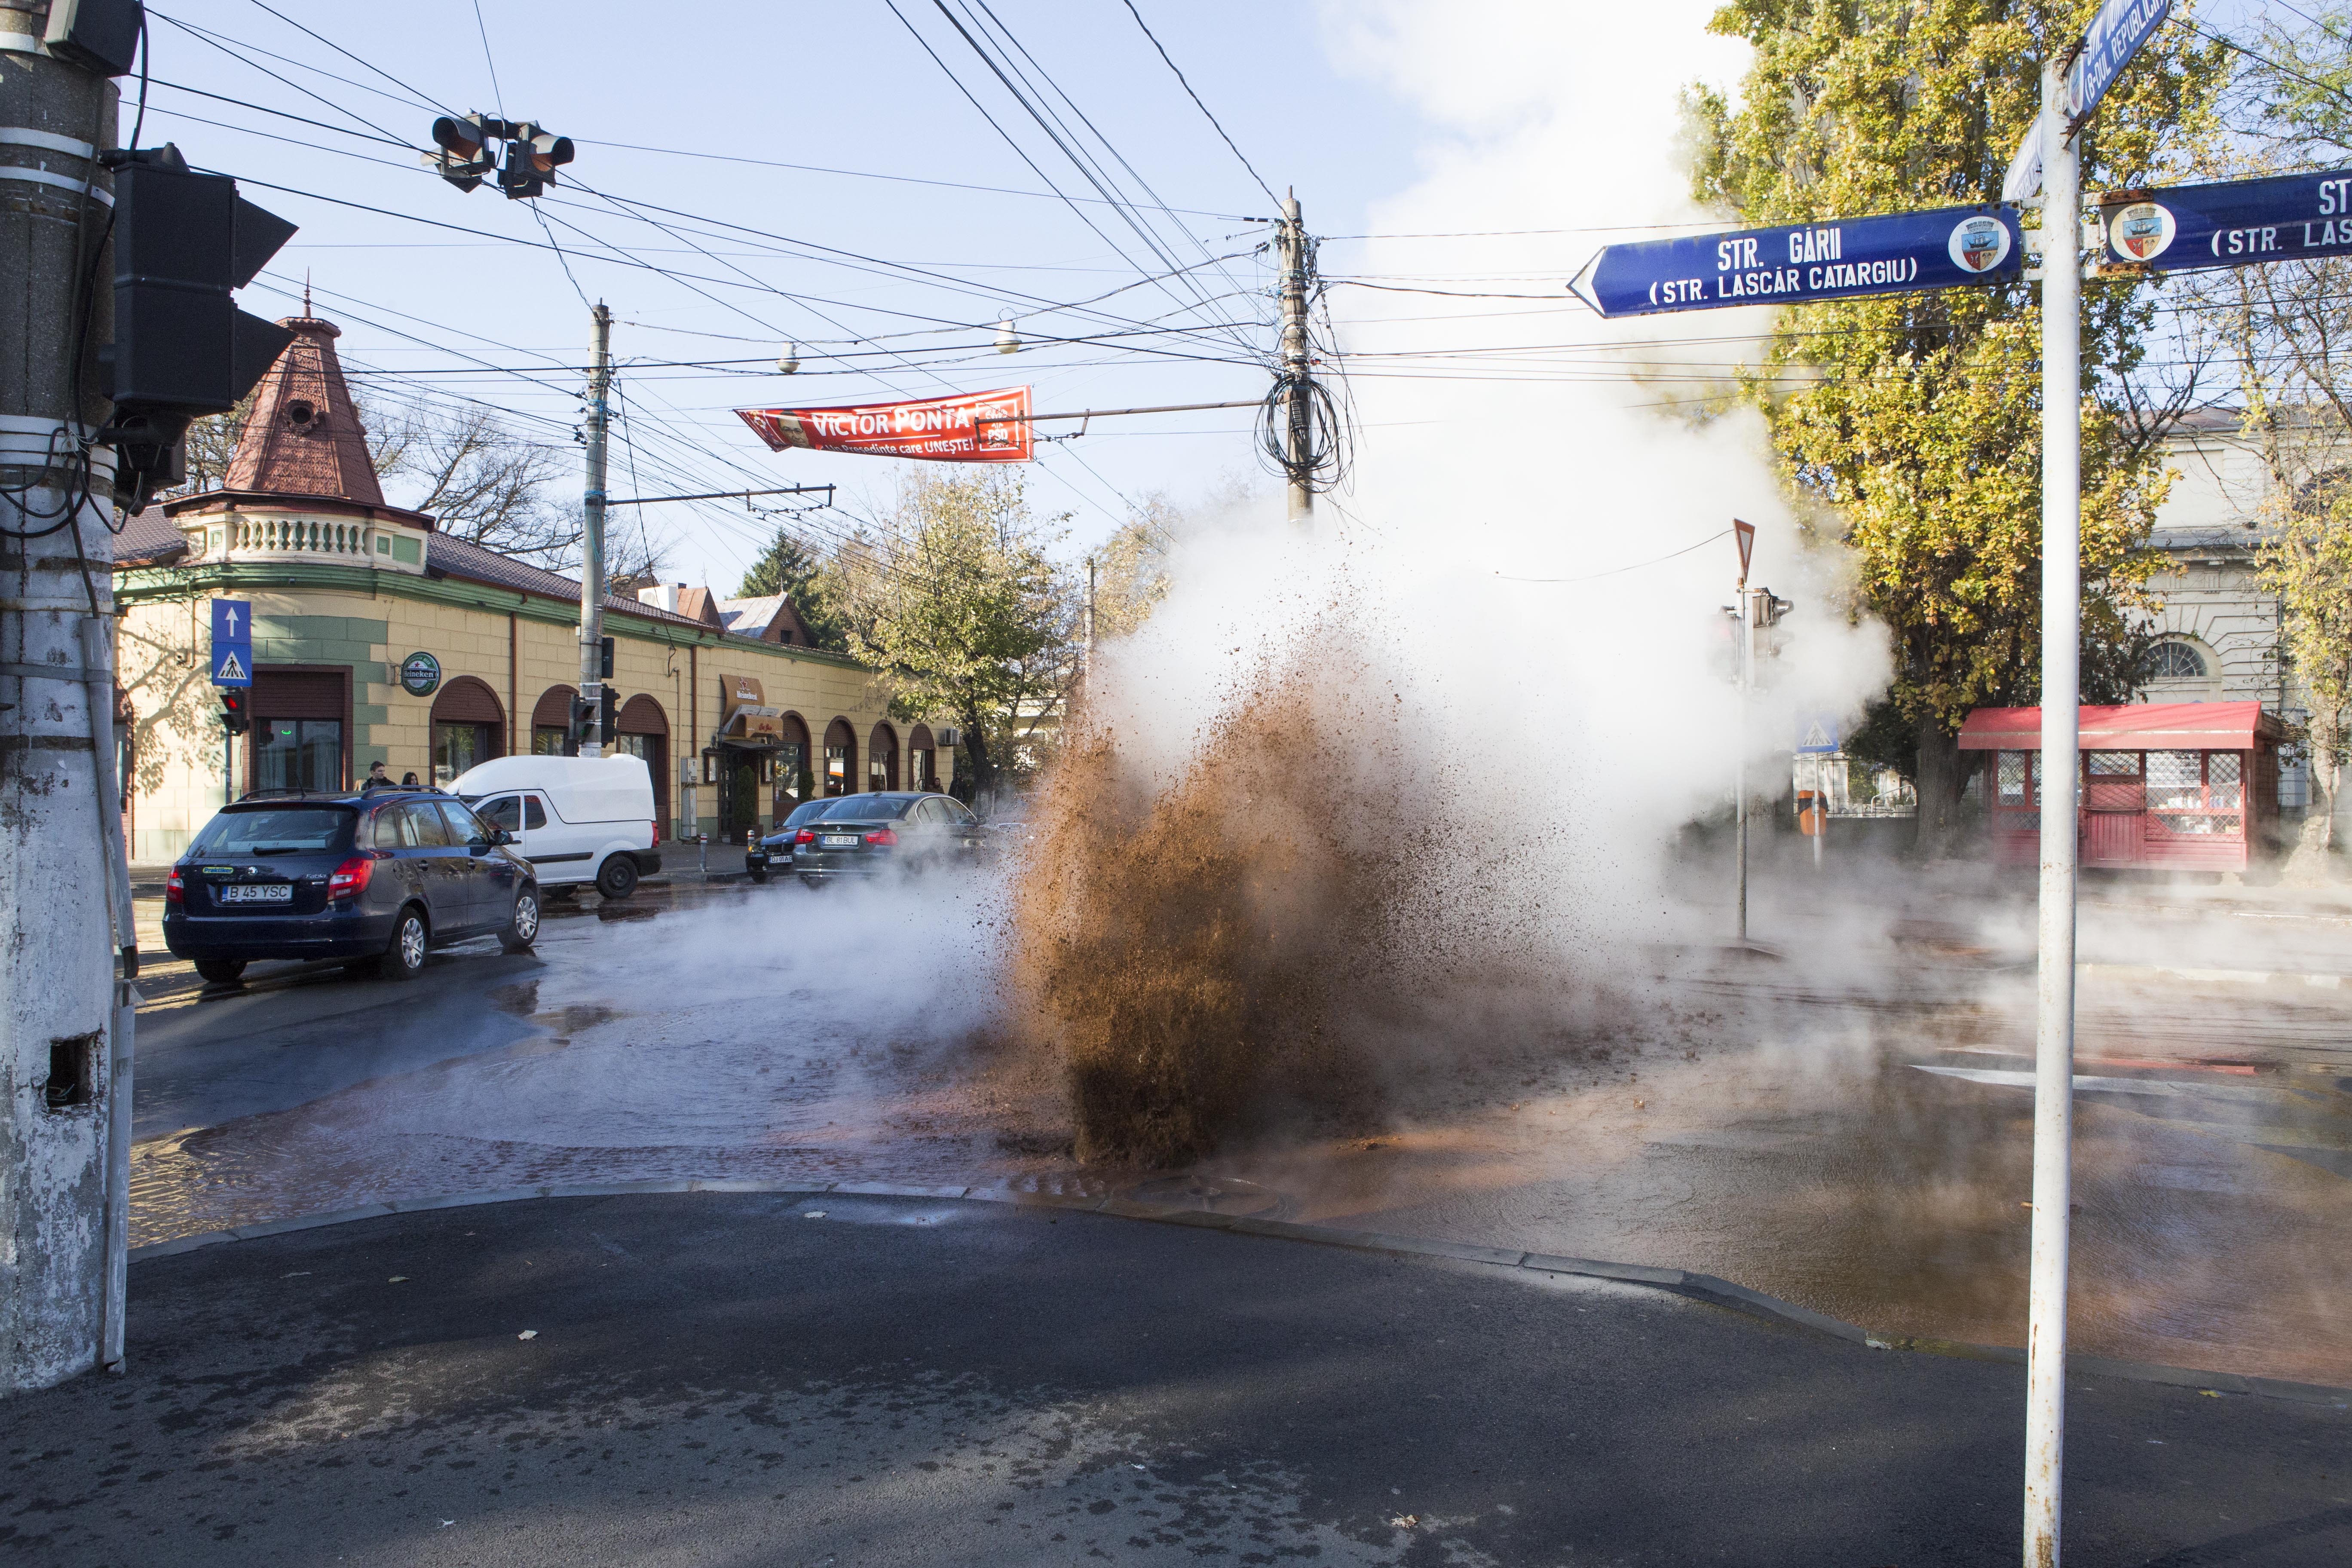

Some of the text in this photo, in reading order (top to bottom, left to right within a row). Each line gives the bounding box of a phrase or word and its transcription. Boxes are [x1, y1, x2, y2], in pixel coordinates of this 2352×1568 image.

[1718, 238, 1764, 271] STR.
[2211, 227, 2283, 257] (STR.
[1649, 279, 1708, 305] (STR.
[1809, 257, 1917, 289] CATARGIU)
[812, 407, 970, 436] VICTOR PONTA
[988, 429, 1008, 441] PSD
[899, 444, 923, 454] care
[230, 886, 288, 897] B 45 YSC
